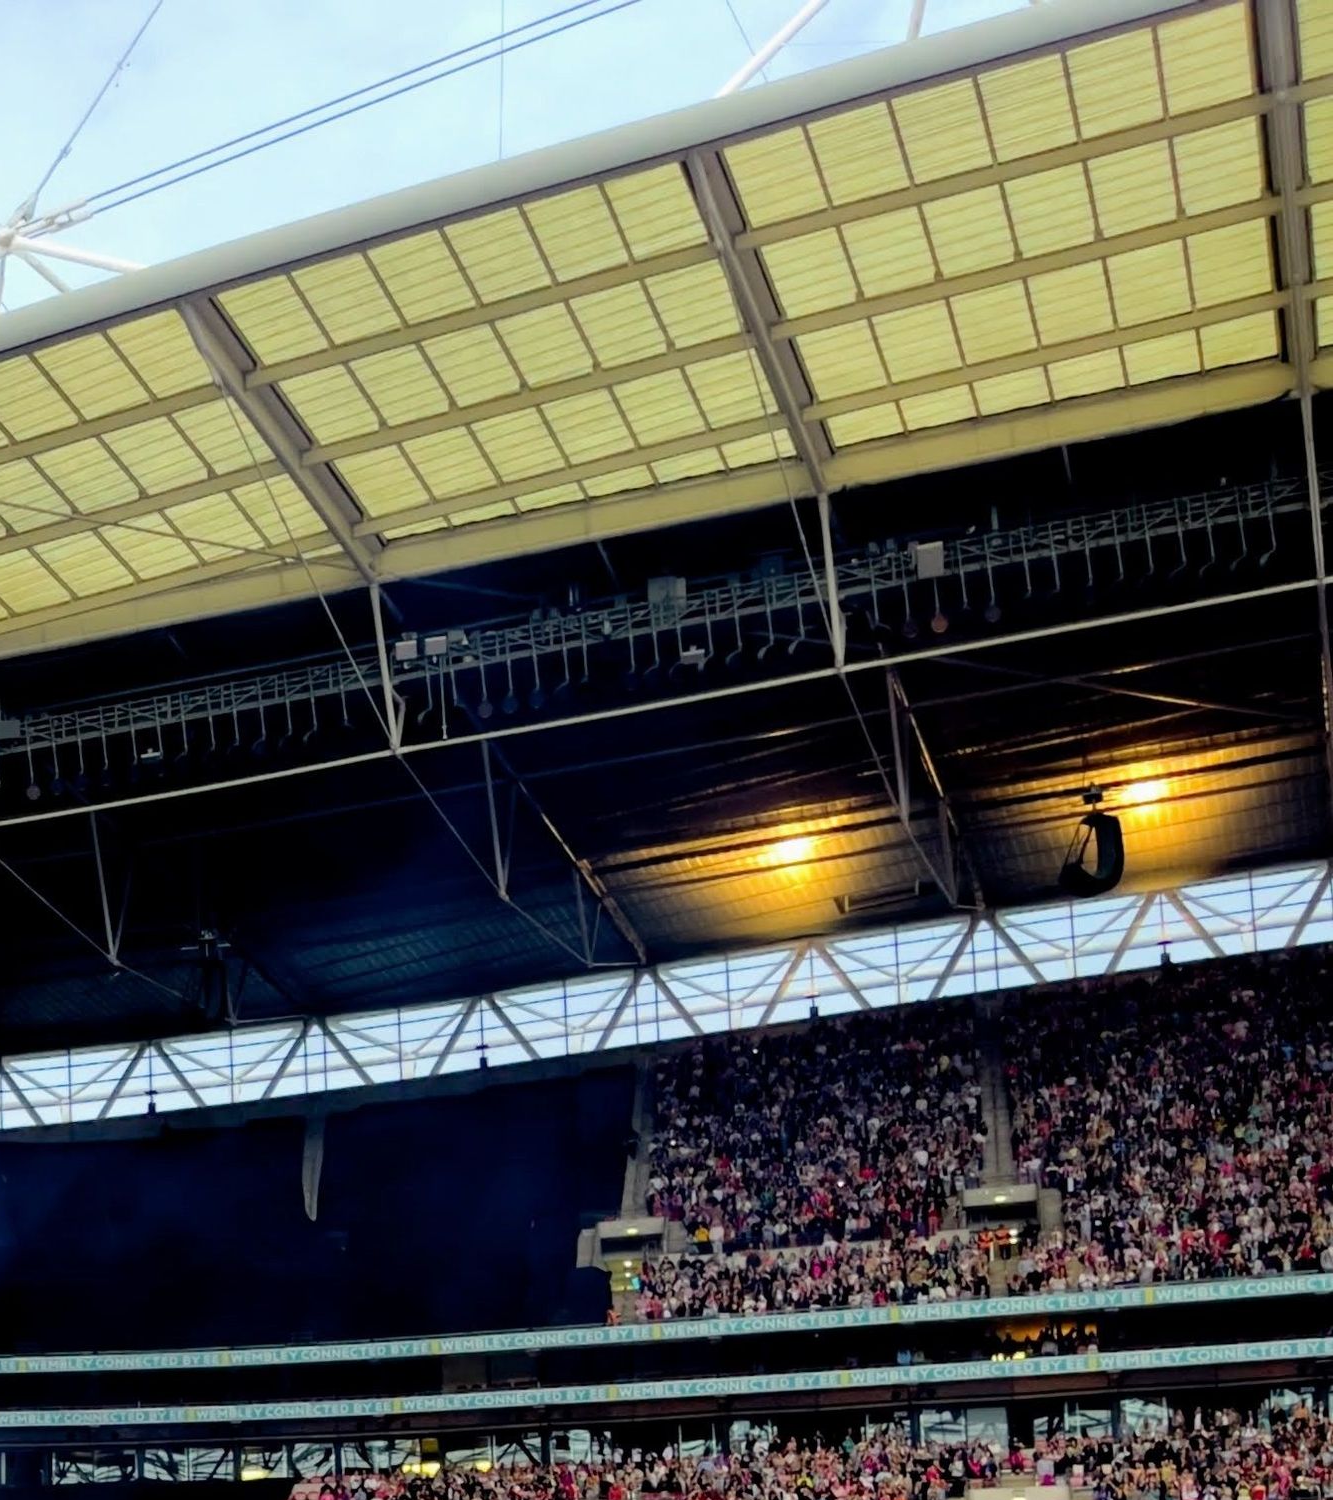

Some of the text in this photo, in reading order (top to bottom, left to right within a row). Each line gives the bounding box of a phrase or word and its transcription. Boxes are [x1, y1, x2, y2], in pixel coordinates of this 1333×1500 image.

[1155, 1276, 1333, 1301] WEMBLEY CONNECT
[902, 1290, 1142, 1319] WEMBLEY CONNECTED BY EE
[663, 1309, 889, 1337] WEMBLEY CONNECTED BY EE
[440, 1327, 649, 1351] WEMBLEY CONNECTED BY EE
[95, 1354, 177, 1368] CONNECTED
[183, 1354, 200, 1365] BY
[203, 1353, 218, 1364] EE
[231, 1341, 431, 1363] WEMBLEY CONNECTED BY EE
[1100, 1351, 1183, 1368] WEMBLEY
[1187, 1343, 1291, 1363] CONNECTED
[1297, 1342, 1319, 1355] BY
[850, 1357, 1083, 1383] WEMBLEY CONNECTED BY EE
[619, 1373, 838, 1398] WEMBLEY CONNECTED BY EE
[197, 1401, 391, 1420] WEMBLEY CONNECTED BY EE
[403, 1388, 606, 1411] WEMBLEY CONNECTED BY EE
[64, 1411, 144, 1423] CONNECTED
[149, 1410, 166, 1421] BY
[169, 1410, 183, 1421] EE
